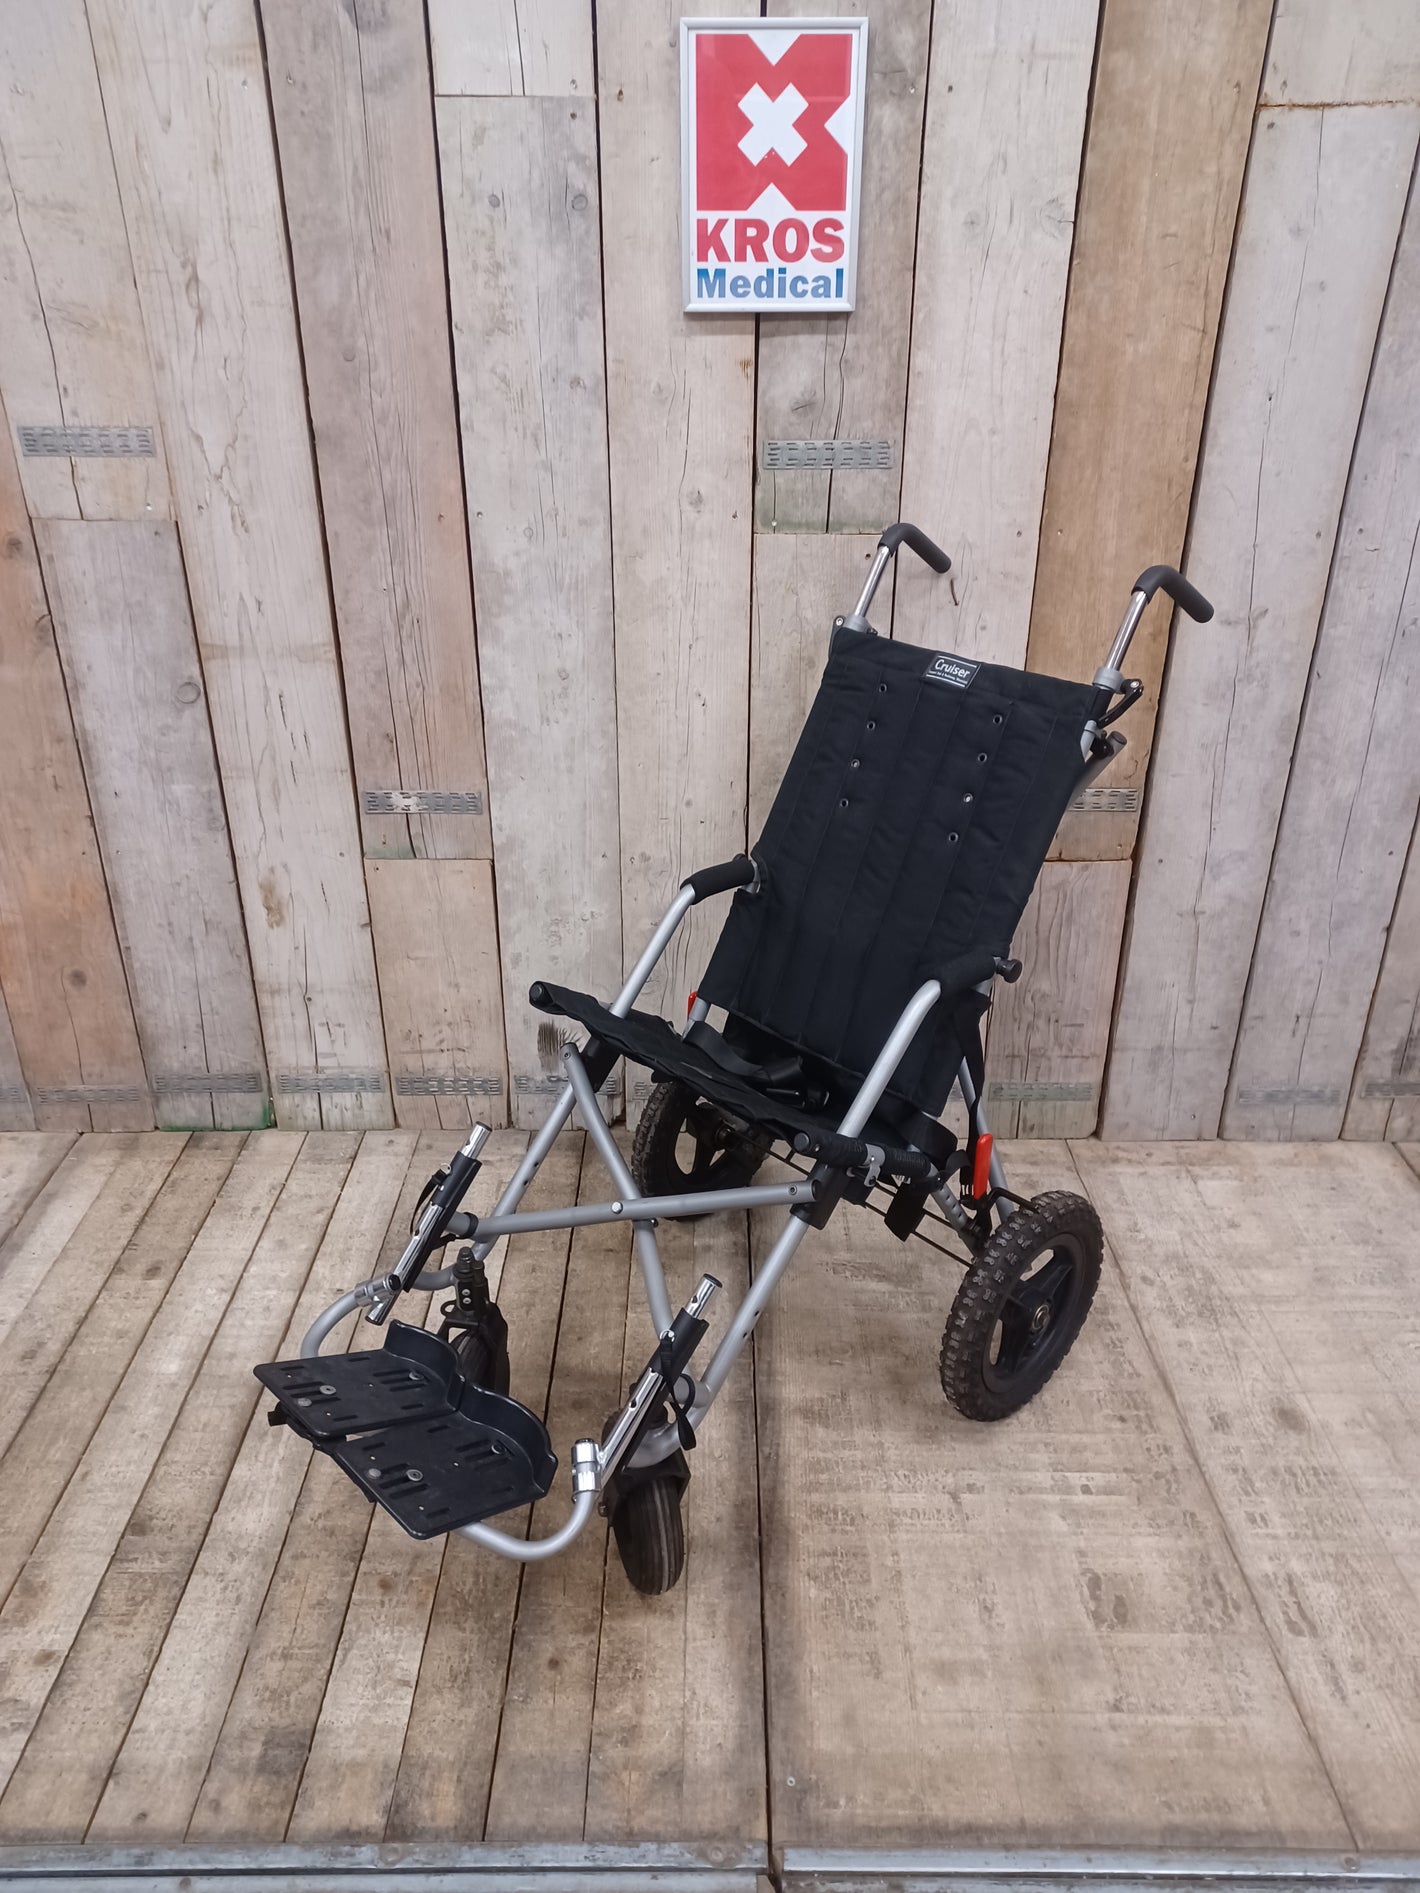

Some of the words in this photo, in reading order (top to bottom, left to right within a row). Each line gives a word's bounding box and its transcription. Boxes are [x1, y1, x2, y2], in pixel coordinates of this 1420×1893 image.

[696, 218, 845, 263] KROS
[696, 267, 844, 299] Medical
[934, 658, 970, 678] Cruiser
